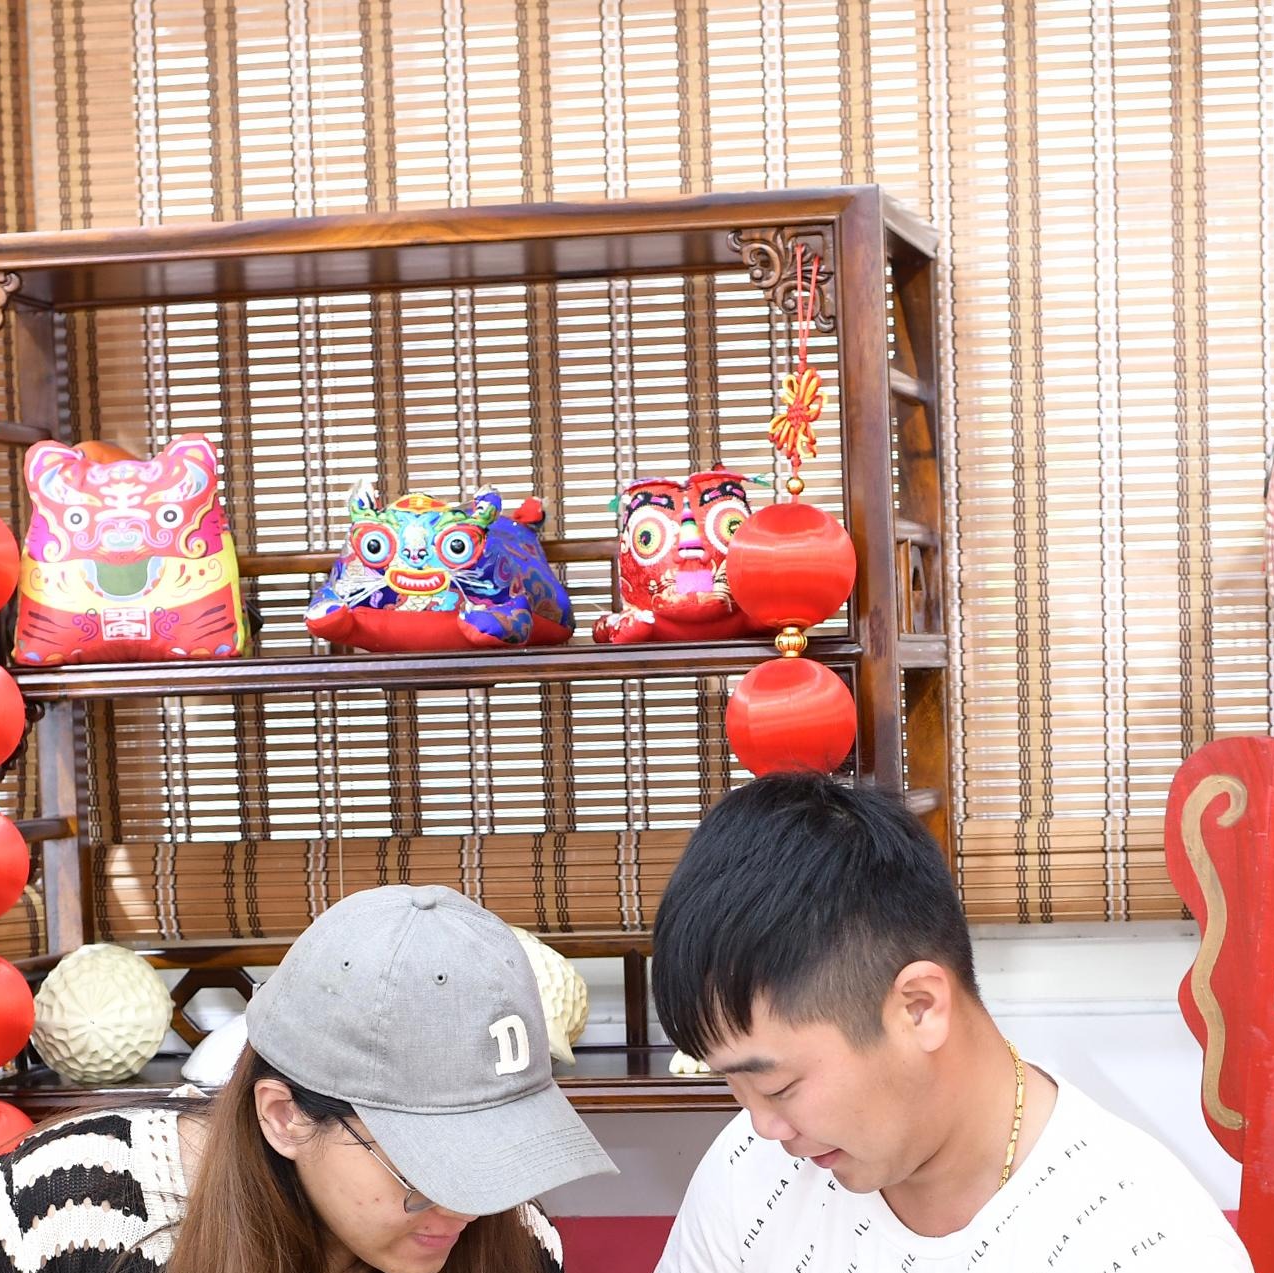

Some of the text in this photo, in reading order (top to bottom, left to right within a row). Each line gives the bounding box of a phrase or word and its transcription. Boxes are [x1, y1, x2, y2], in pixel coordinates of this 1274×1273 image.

[488, 1015, 530, 1076] D
[729, 1135, 755, 1168] FILA
[743, 1218, 765, 1249] FILA
[766, 1179, 789, 1210] FILA
[1048, 1234, 1070, 1267] FILA
[1076, 1194, 1107, 1225] FILA
[1131, 1231, 1166, 1257] FILA
